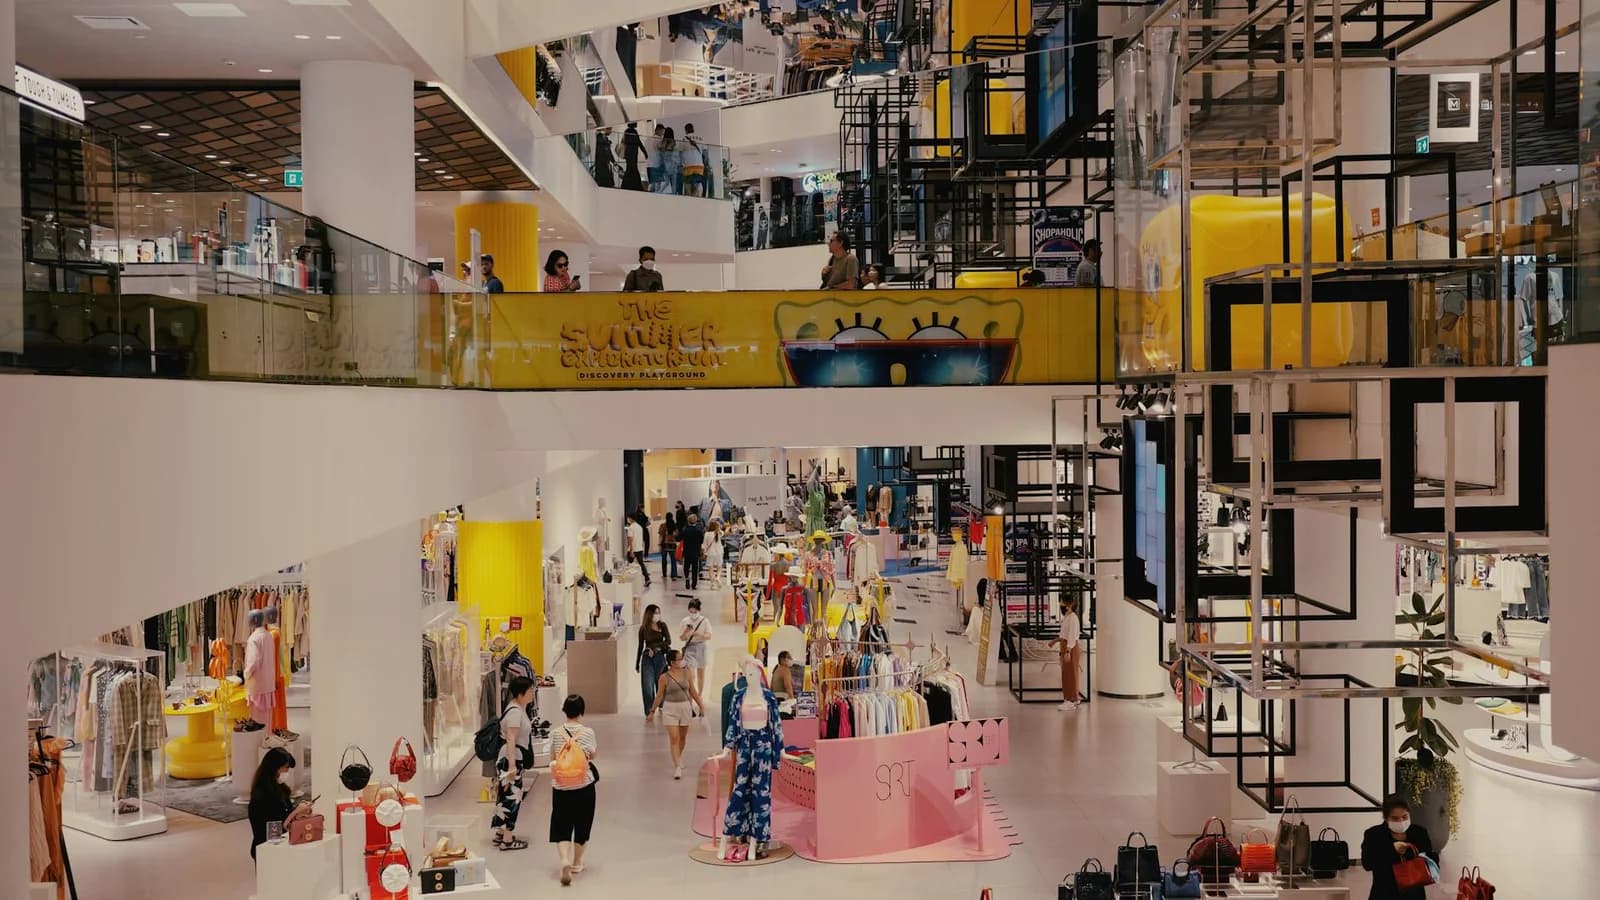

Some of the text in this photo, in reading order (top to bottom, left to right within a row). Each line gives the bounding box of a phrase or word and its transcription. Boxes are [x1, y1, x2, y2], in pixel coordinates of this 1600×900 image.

[1035, 227, 1083, 246] SHOPAHOLIC
[618, 299, 673, 321] THE
[560, 320, 719, 352] SUMMER
[579, 371, 706, 379] DISCOVERY PLAYGROUND
